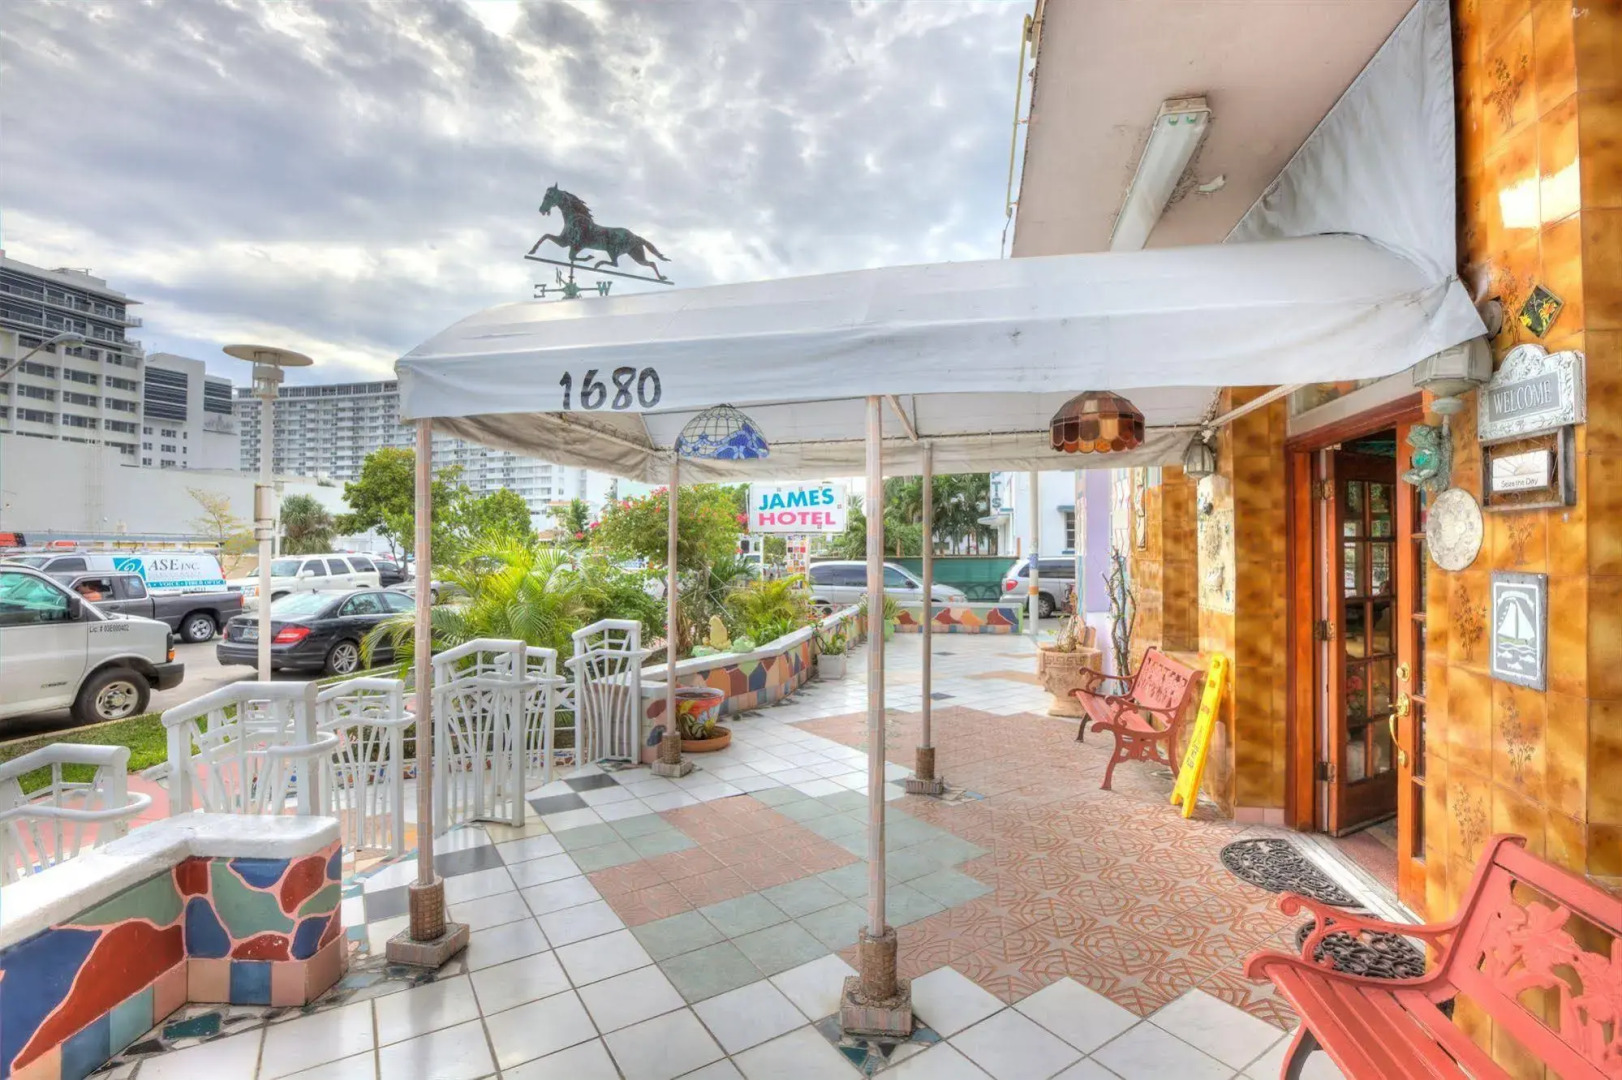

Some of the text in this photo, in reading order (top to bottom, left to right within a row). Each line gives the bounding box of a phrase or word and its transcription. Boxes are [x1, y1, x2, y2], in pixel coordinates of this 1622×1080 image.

[596, 281, 613, 296] W
[559, 366, 661, 410] 1680
[1493, 381, 1552, 415] WELCOME
[1525, 477, 1539, 486] Day
[759, 488, 834, 511] JAMES
[758, 511, 836, 526] HOTEL
[149, 559, 179, 571] ASE
